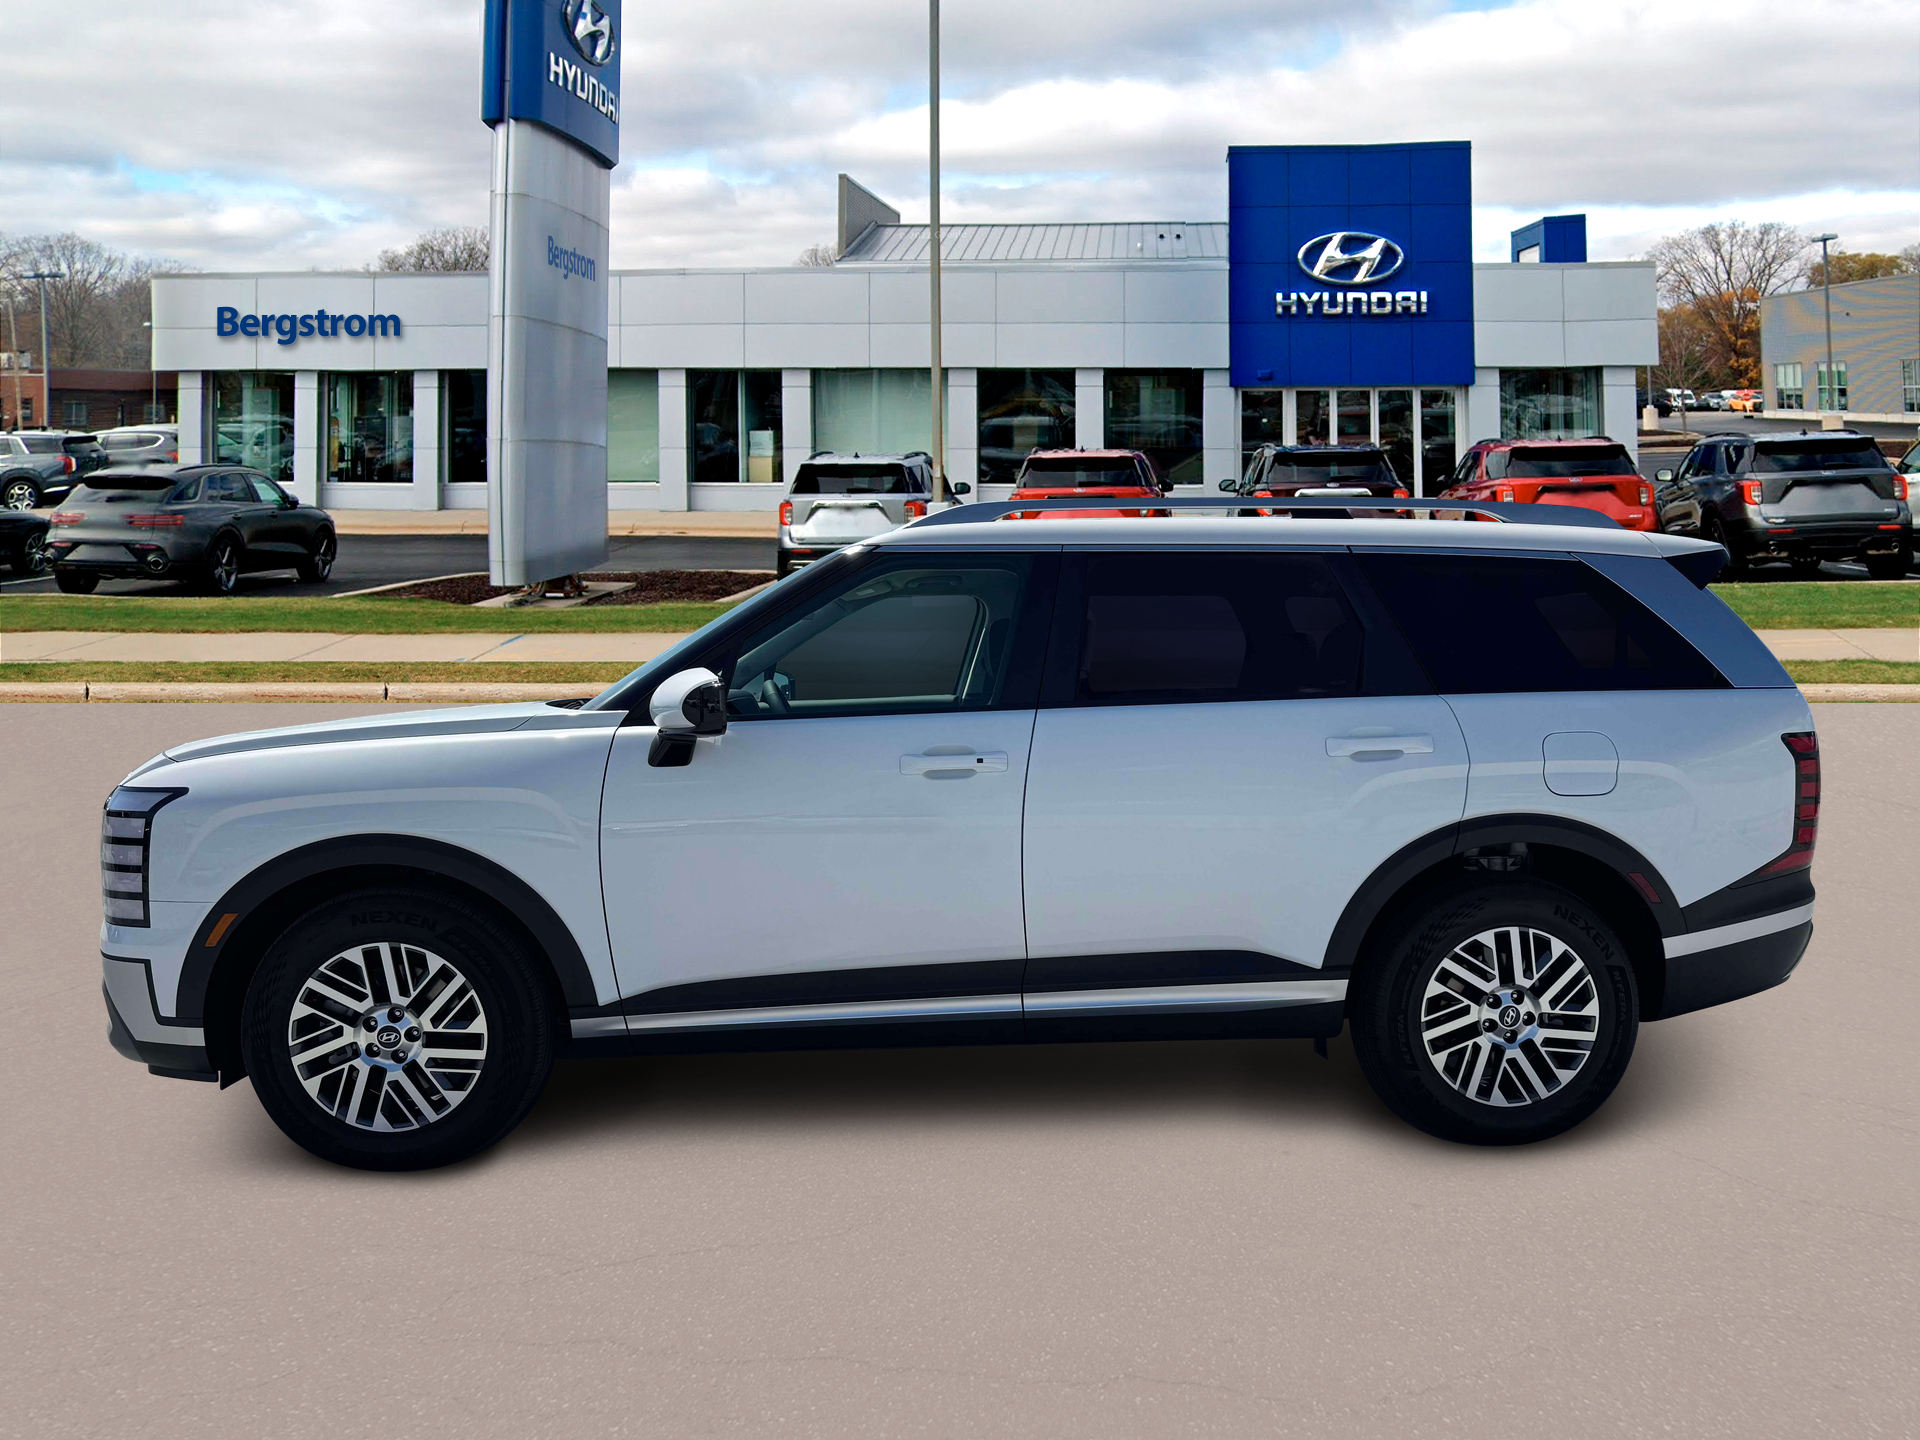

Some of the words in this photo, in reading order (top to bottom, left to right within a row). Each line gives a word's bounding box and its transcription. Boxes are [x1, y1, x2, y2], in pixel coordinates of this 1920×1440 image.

[548, 51, 619, 124] HYUNDAI
[548, 235, 596, 282] Bergstrom
[1275, 291, 1428, 315] HYUNDAI
[217, 306, 401, 346] Bergstrom
[351, 910, 439, 932] NEXEN
[1553, 904, 1615, 961] NEXEN
